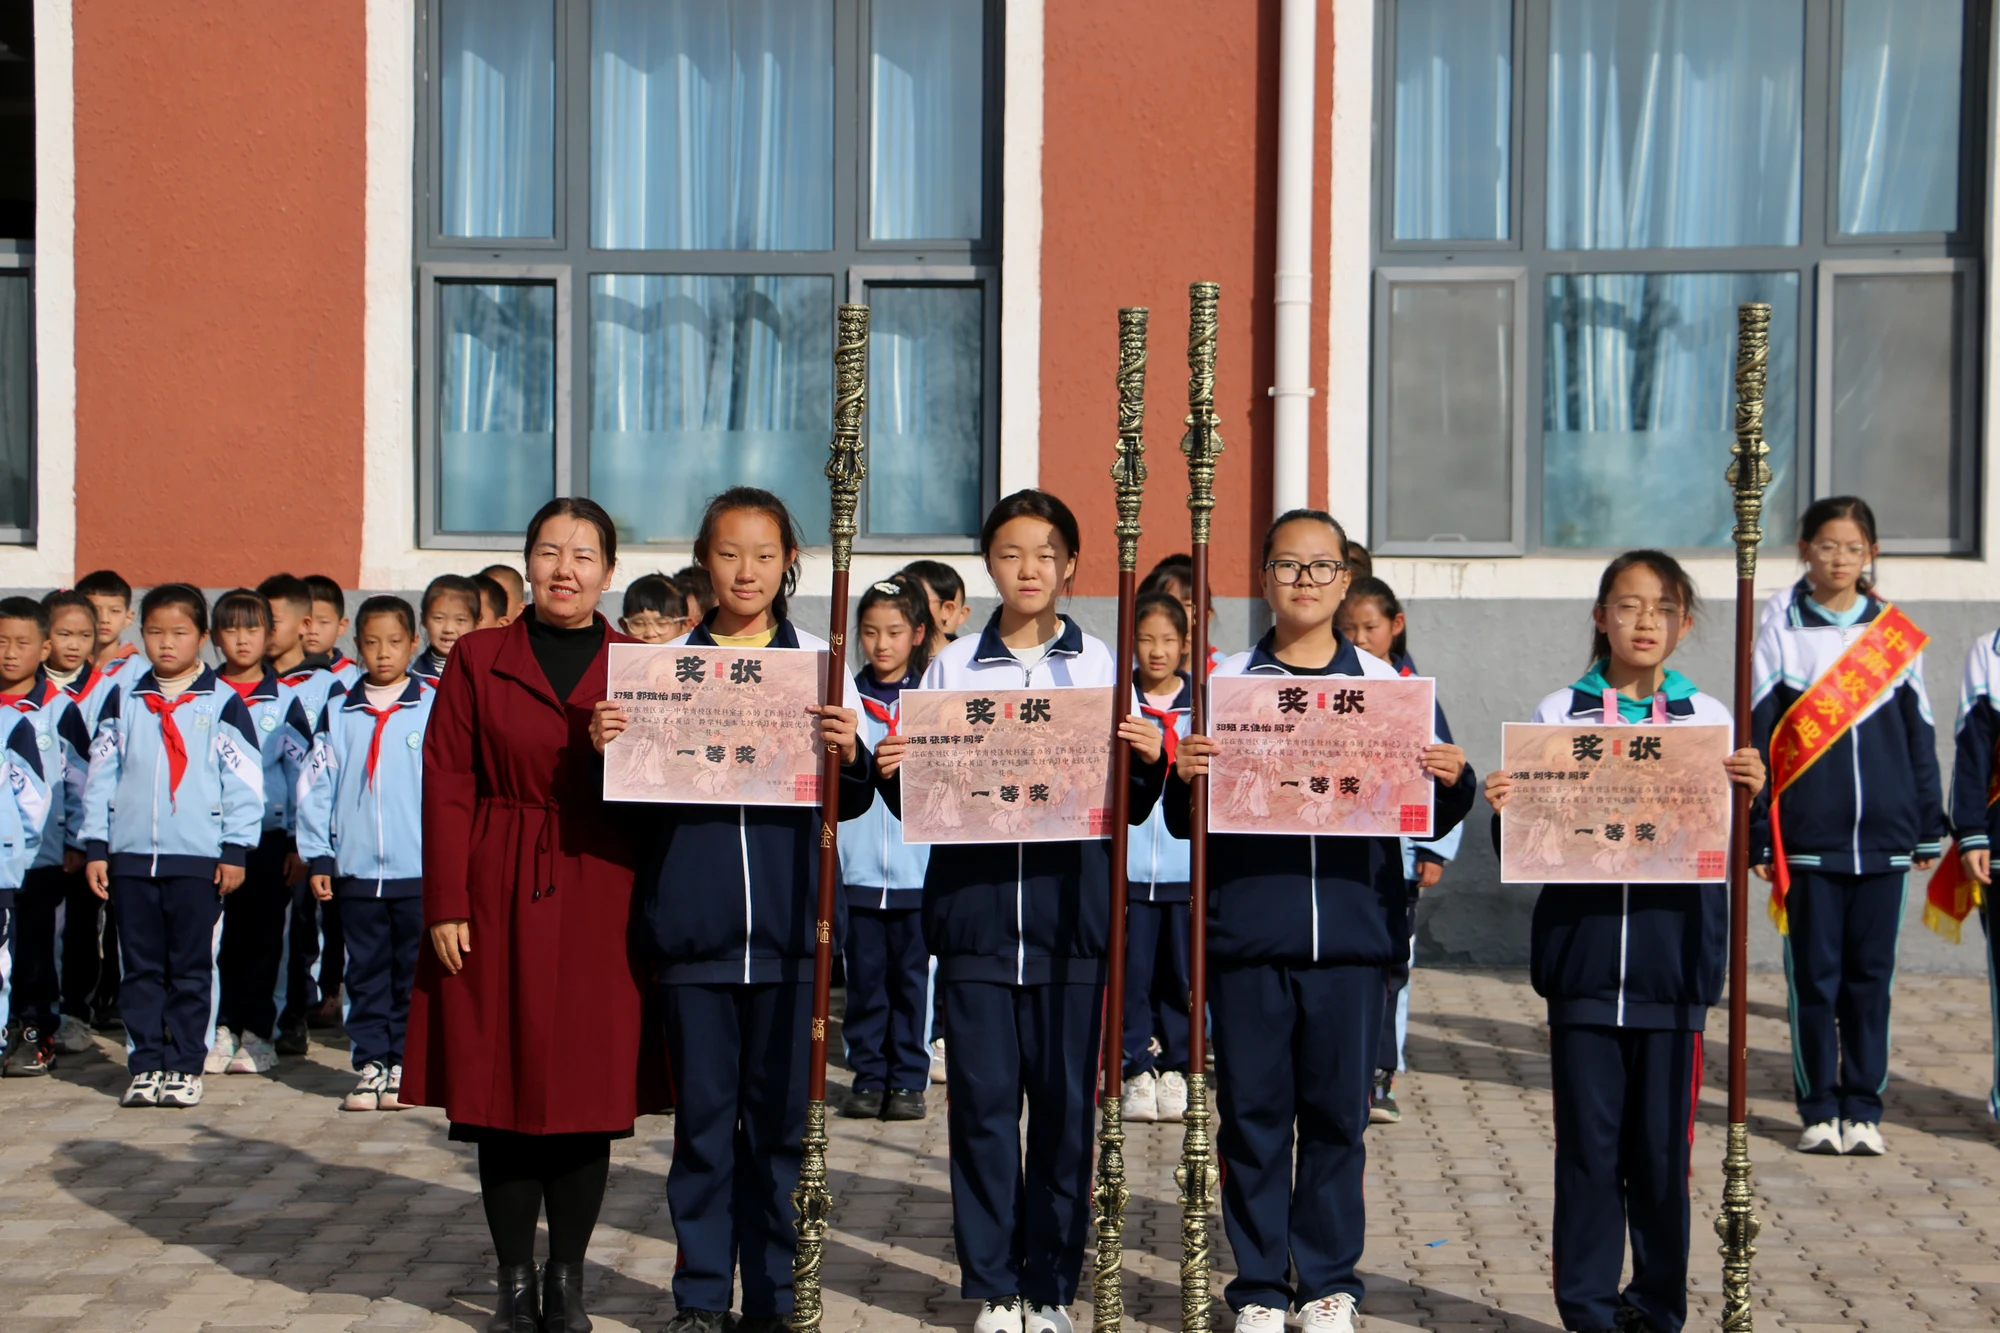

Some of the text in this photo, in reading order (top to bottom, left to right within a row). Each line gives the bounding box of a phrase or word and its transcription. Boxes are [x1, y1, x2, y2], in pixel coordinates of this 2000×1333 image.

[675, 656, 762, 684] 奖状
[671, 693, 692, 701] 同学
[1278, 687, 1365, 714] 奖状
[966, 698, 1051, 724] 奖状
[1216, 724, 1236, 732] 38班
[1274, 724, 1295, 733] 同学
[963, 735, 984, 744] 同学
[1572, 734, 1661, 761] 奖状
[676, 746, 756, 763] 一等奖
[1568, 772, 1590, 780] 同学
[972, 784, 1049, 802] 一等奖
[1280, 776, 1360, 794] 一等奖
[1575, 824, 1656, 841] 一等奖
